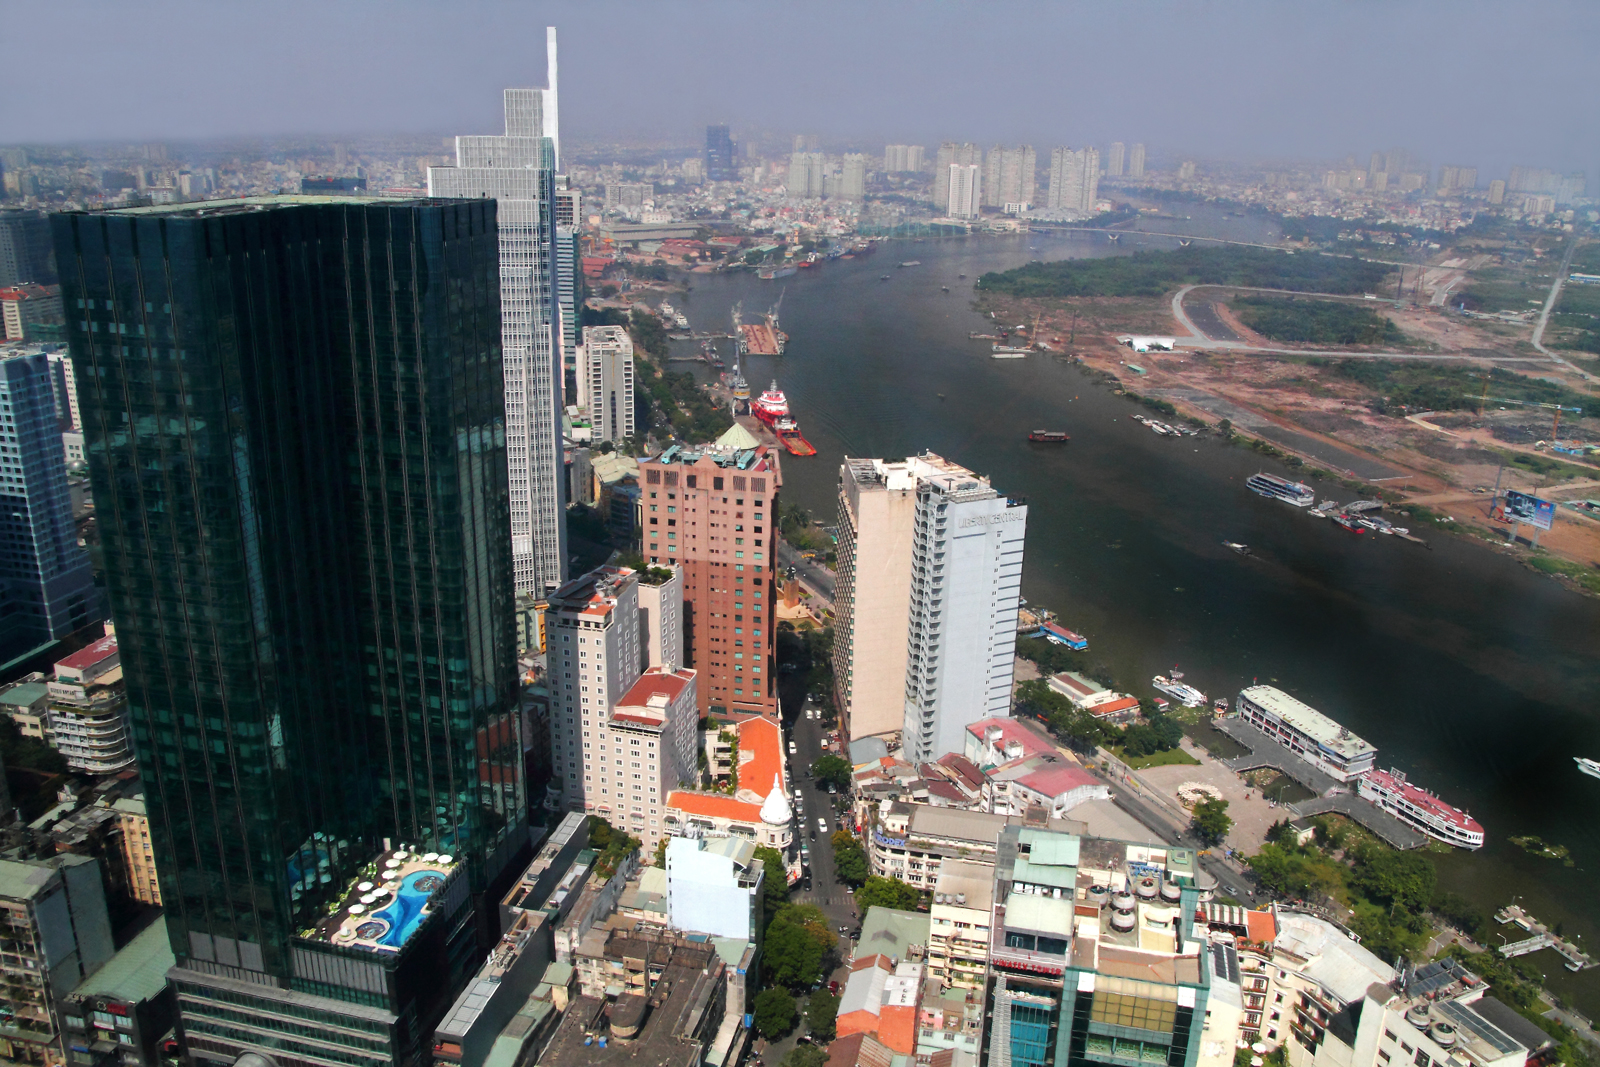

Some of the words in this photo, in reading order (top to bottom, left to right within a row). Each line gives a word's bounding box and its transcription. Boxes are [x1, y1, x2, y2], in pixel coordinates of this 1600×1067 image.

[959, 515, 987, 528] LIBERTY
[989, 511, 1023, 524] CENTRAL
[993, 959, 1028, 970] VINATEX
[1032, 965, 1061, 975] TOWER
